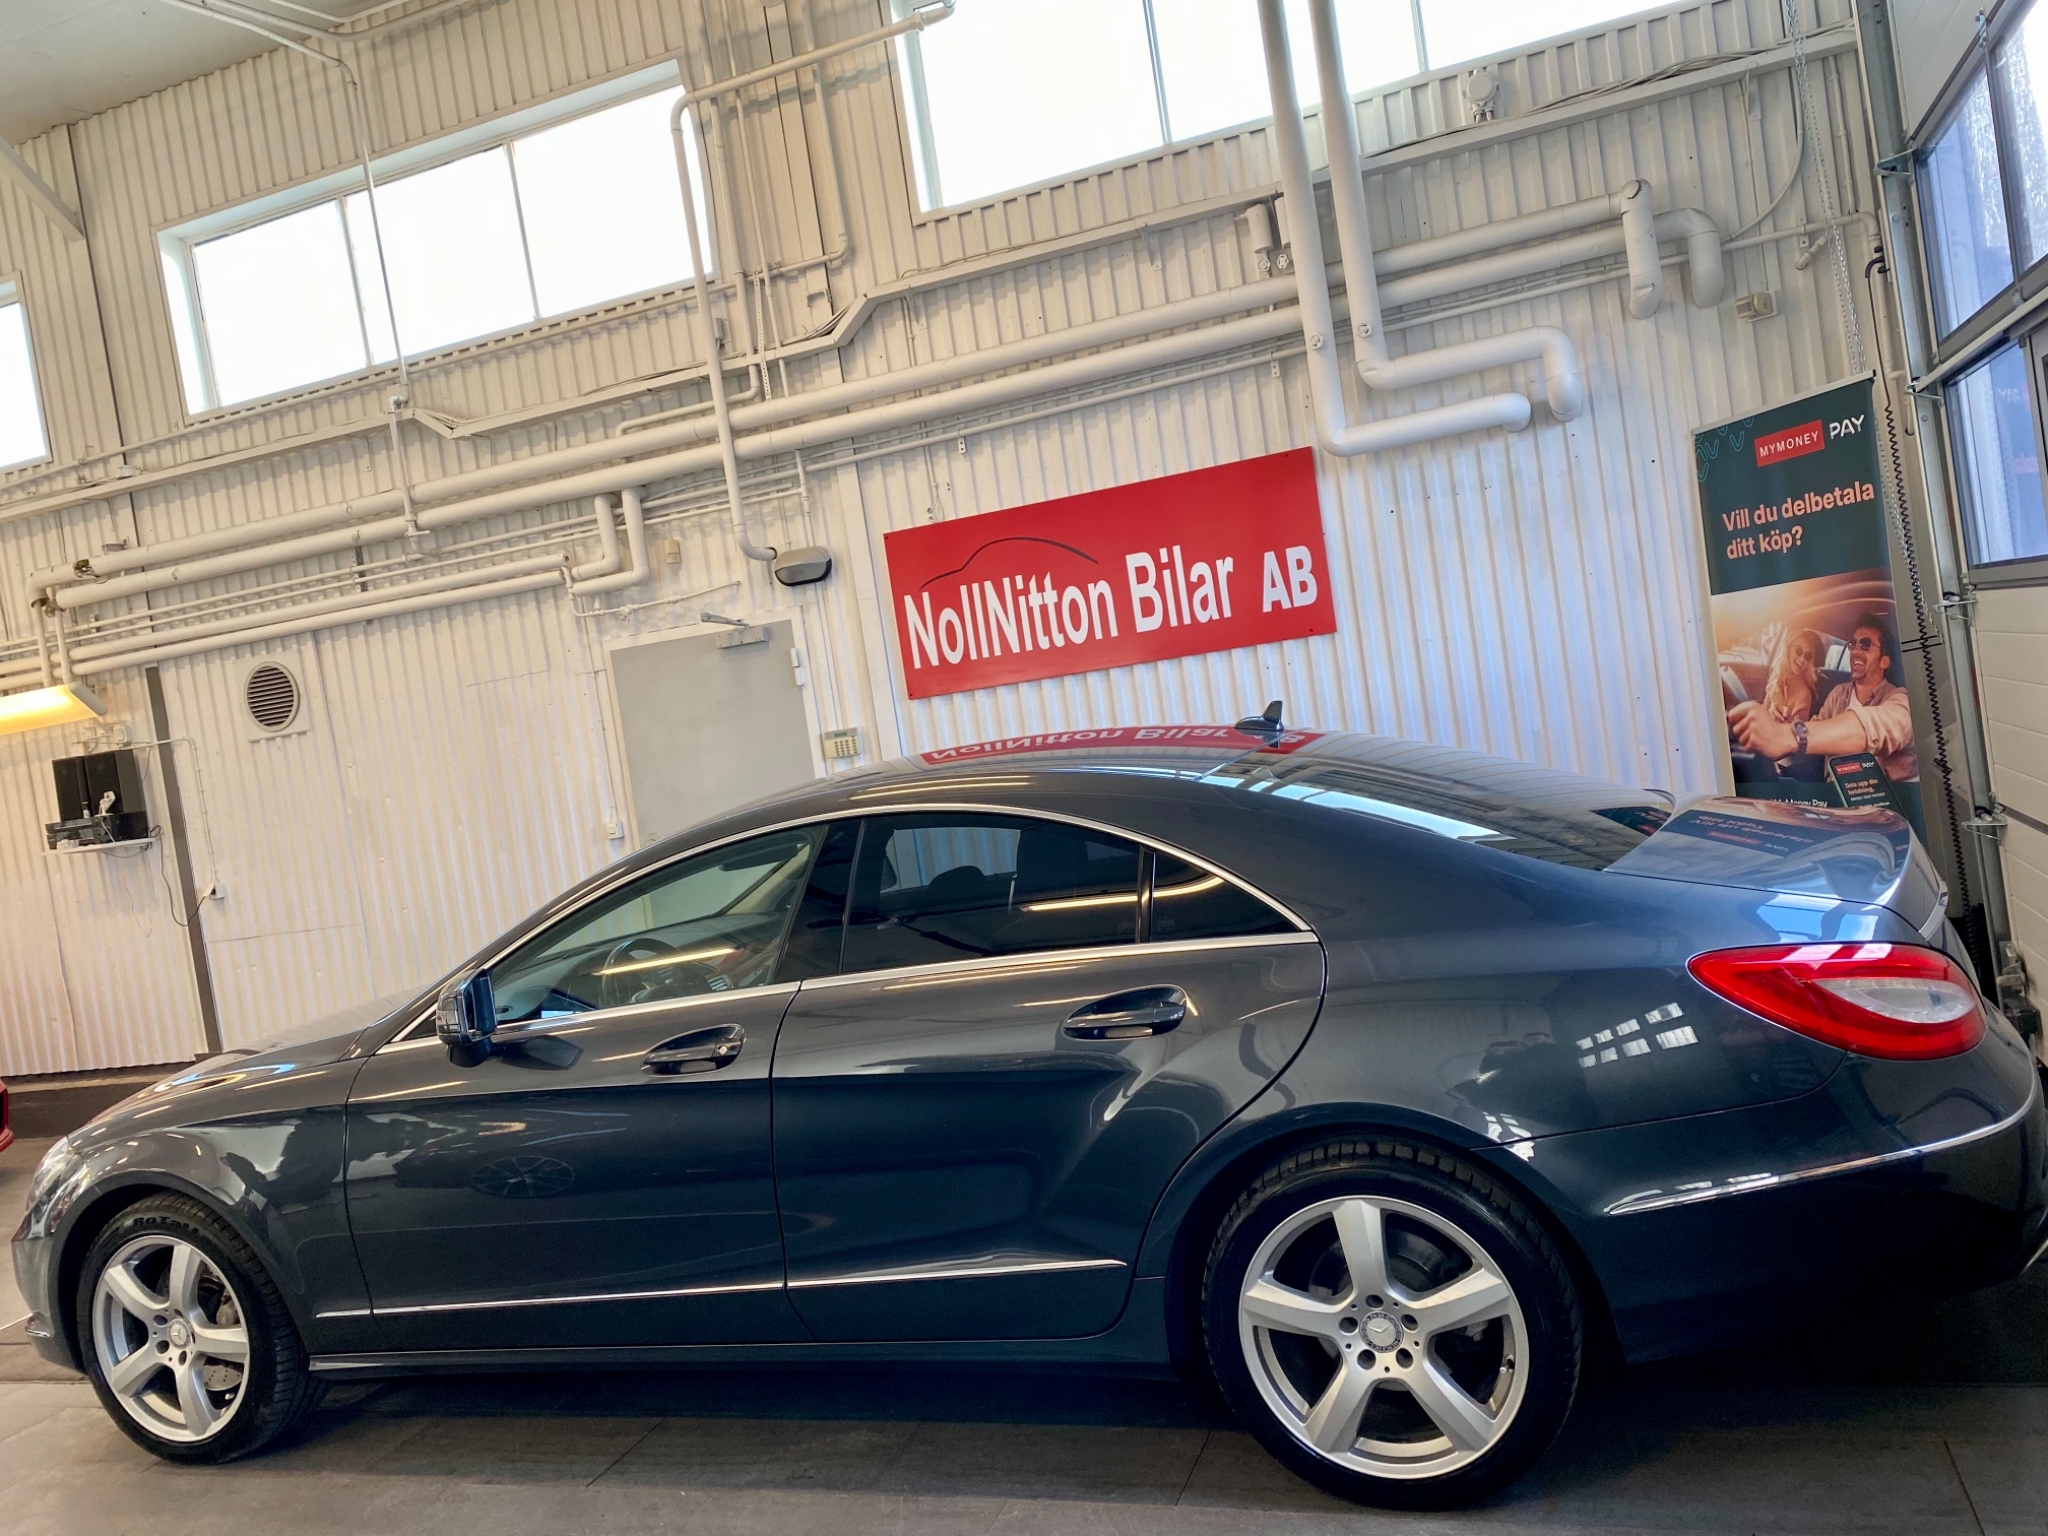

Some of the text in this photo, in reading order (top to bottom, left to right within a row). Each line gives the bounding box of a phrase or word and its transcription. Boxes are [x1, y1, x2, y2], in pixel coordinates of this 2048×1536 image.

[1759, 414, 1865, 457] MYMONEY PAY
[1722, 481, 1875, 531] Vill du delbetala
[1726, 525, 1803, 560] ditt köp?
[903, 544, 1318, 669] NollNitton Bilar AB
